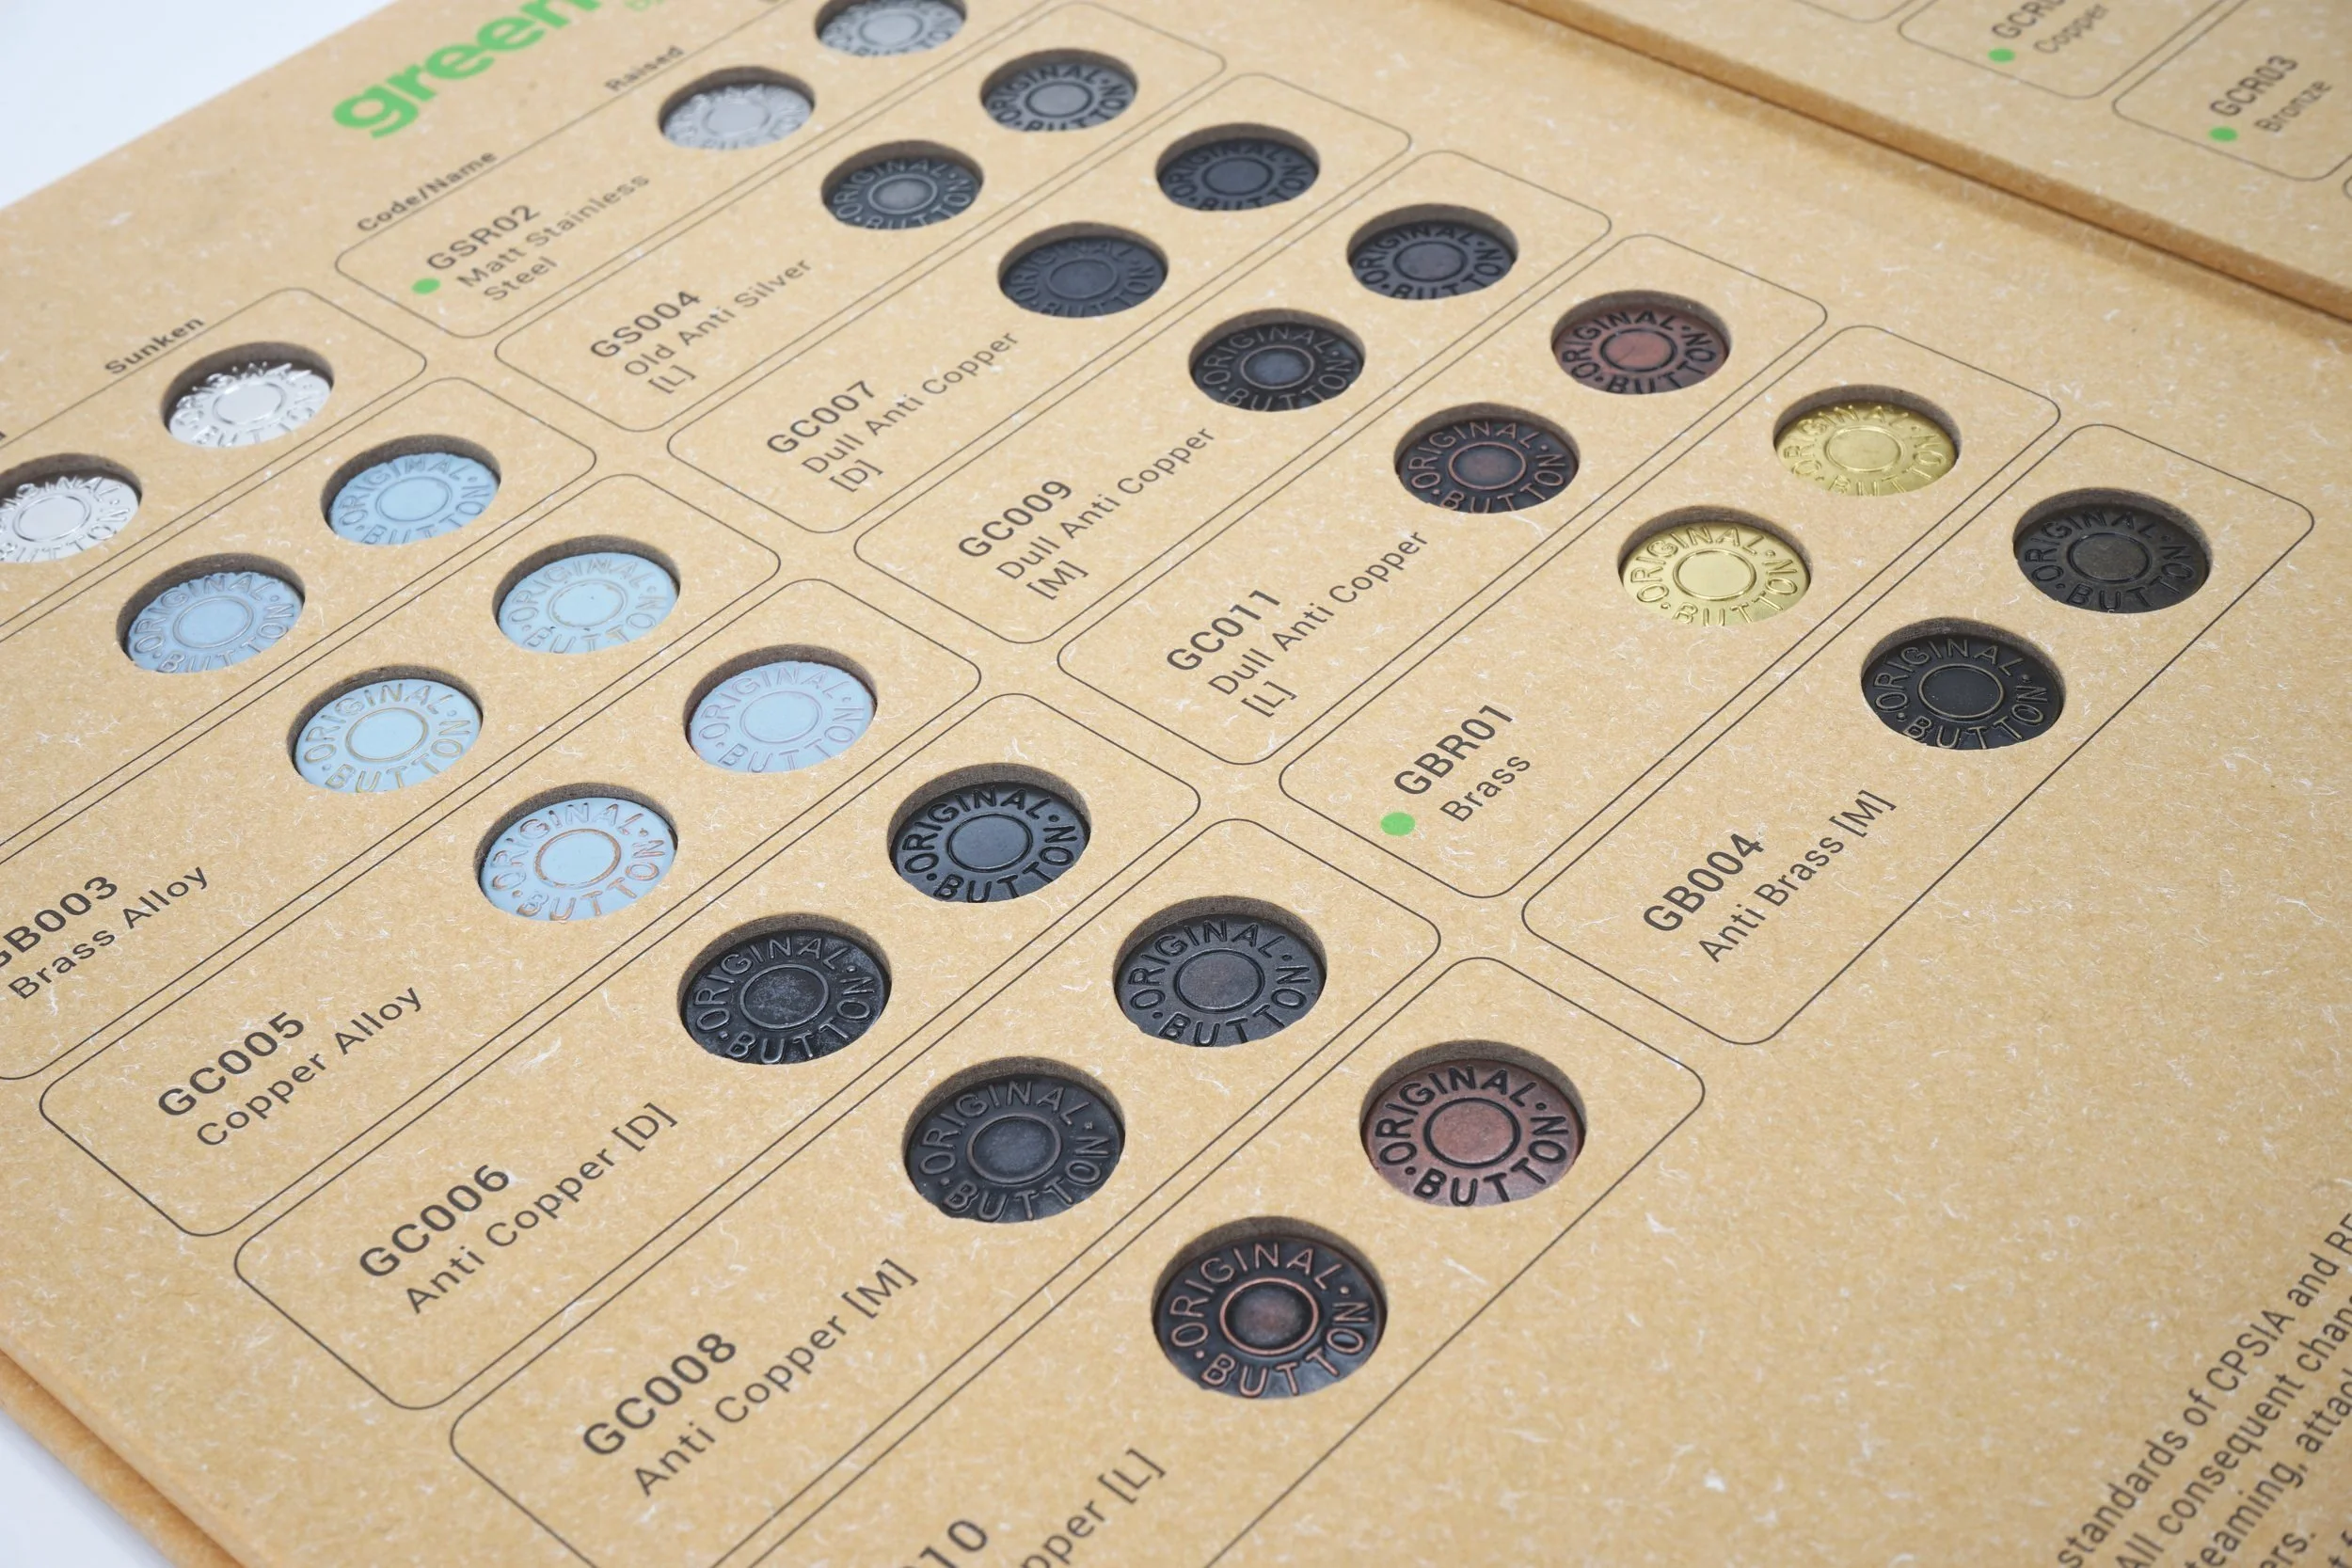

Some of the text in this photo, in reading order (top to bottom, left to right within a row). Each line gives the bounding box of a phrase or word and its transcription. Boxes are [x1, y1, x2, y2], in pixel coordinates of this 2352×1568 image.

[605, 45, 685, 92] Raised
[2033, 3, 2110, 55] Copper
[2209, 55, 2299, 118] GCR03
[2254, 79, 2333, 134] Bronze
[357, 150, 498, 234] Code/Name
[426, 205, 541, 271] GSR02
[456, 175, 650, 288] Matt Stainless
[833, 158, 952, 218] ORIGINAL
[483, 256, 558, 301] Steel
[1358, 223, 1479, 284] ORIGINAL
[104, 317, 205, 375] Sunken
[590, 291, 700, 358] GS004
[624, 259, 812, 376] Old Anti Silver
[1562, 310, 1718, 394] ORIGINAL BUTTON
[647, 364, 696, 394] [L]
[767, 380, 875, 453] GC007
[801, 332, 1019, 474] Dull Anti Copper
[1203, 327, 1353, 412] ORIGINAL BUTTON
[829, 459, 883, 493] [D]
[995, 427, 1215, 580] Dull Anti Copper
[1406, 420, 1567, 514] ORIGINAL BUTTON
[958, 481, 1073, 558] GC009
[2024, 507, 2194, 613] ORIGINAL BUTTON
[134, 573, 295, 674] ORIGINAL BUTTON
[506, 556, 668, 654] ORIGINAL BUTTON
[1025, 560, 1089, 600] [M]
[1207, 531, 1428, 695] Dull Anti Copper
[1630, 525, 1799, 626] ORIGINAL BUTTON
[1166, 590, 1280, 671] GC011
[302, 682, 472, 793] ORIGINAL BUTTON
[698, 666, 866, 773] ORIGINAL BUTTON
[1241, 680, 1297, 718] [L]
[1872, 637, 2049, 750] ORIGINAL BUTTON
[1394, 705, 1513, 795] GBR01
[1439, 756, 1531, 822] Brass
[490, 801, 666, 922] ORIGINAL BUTTON
[901, 784, 1079, 903] ORIGINAL BUTTON
[1643, 832, 1765, 931] GB004
[1698, 789, 1898, 963] Anti Brass [M]
[8, 866, 208, 999] Brass Alloy
[1128, 919, 1311, 1047] ORIGINAL BUTTON
[694, 935, 875, 1064] ORIGINAL BUTTON
[158, 1011, 304, 1116] GC005
[197, 987, 421, 1146] Copper Alloy
[919, 1080, 1110, 1223] ORIGINAL BUTTON
[1375, 1065, 1569, 1207] ORIGINAL BUTTON
[359, 1164, 510, 1276] GC006
[405, 1101, 678, 1314] Anti Copper [D]
[1169, 1242, 1371, 1398] ORIGINAL BUTTON
[2183, 1387, 2217, 1427] of
[2205, 1308, 2296, 1393] CPSIA
[2287, 1252, 2340, 1308] and
[582, 1332, 737, 1456] GC008
[634, 1258, 919, 1497] Anti Copper [M]
[2157, 1372, 2305, 1537] consequent
[2296, 1294, 2352, 1373] chan
[1097, 1448, 1167, 1505] [L]
